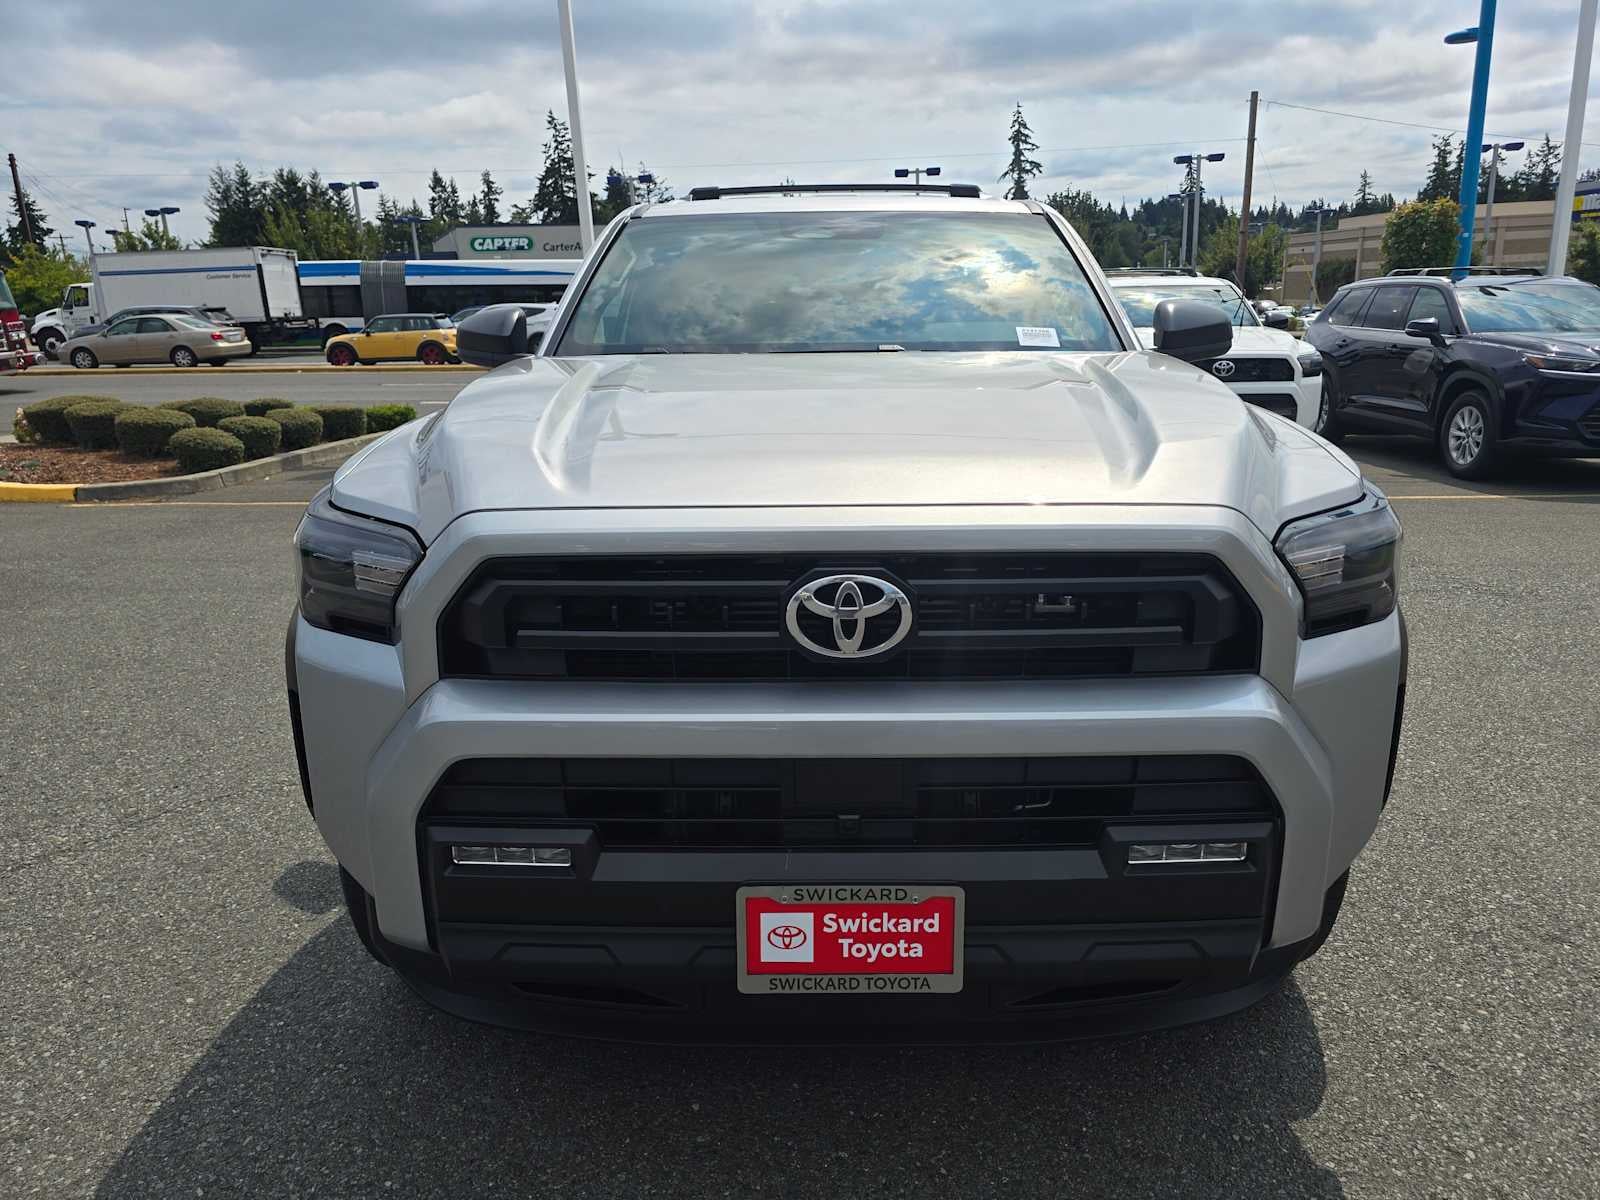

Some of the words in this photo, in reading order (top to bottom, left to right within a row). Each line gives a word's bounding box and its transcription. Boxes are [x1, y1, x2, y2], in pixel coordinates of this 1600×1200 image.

[793, 888, 907, 902] SWICKARD
[823, 912, 940, 933] Swickard
[838, 938, 923, 962] Toyota
[769, 977, 860, 990] SWICKARD
[864, 976, 931, 990] TOYOTA
